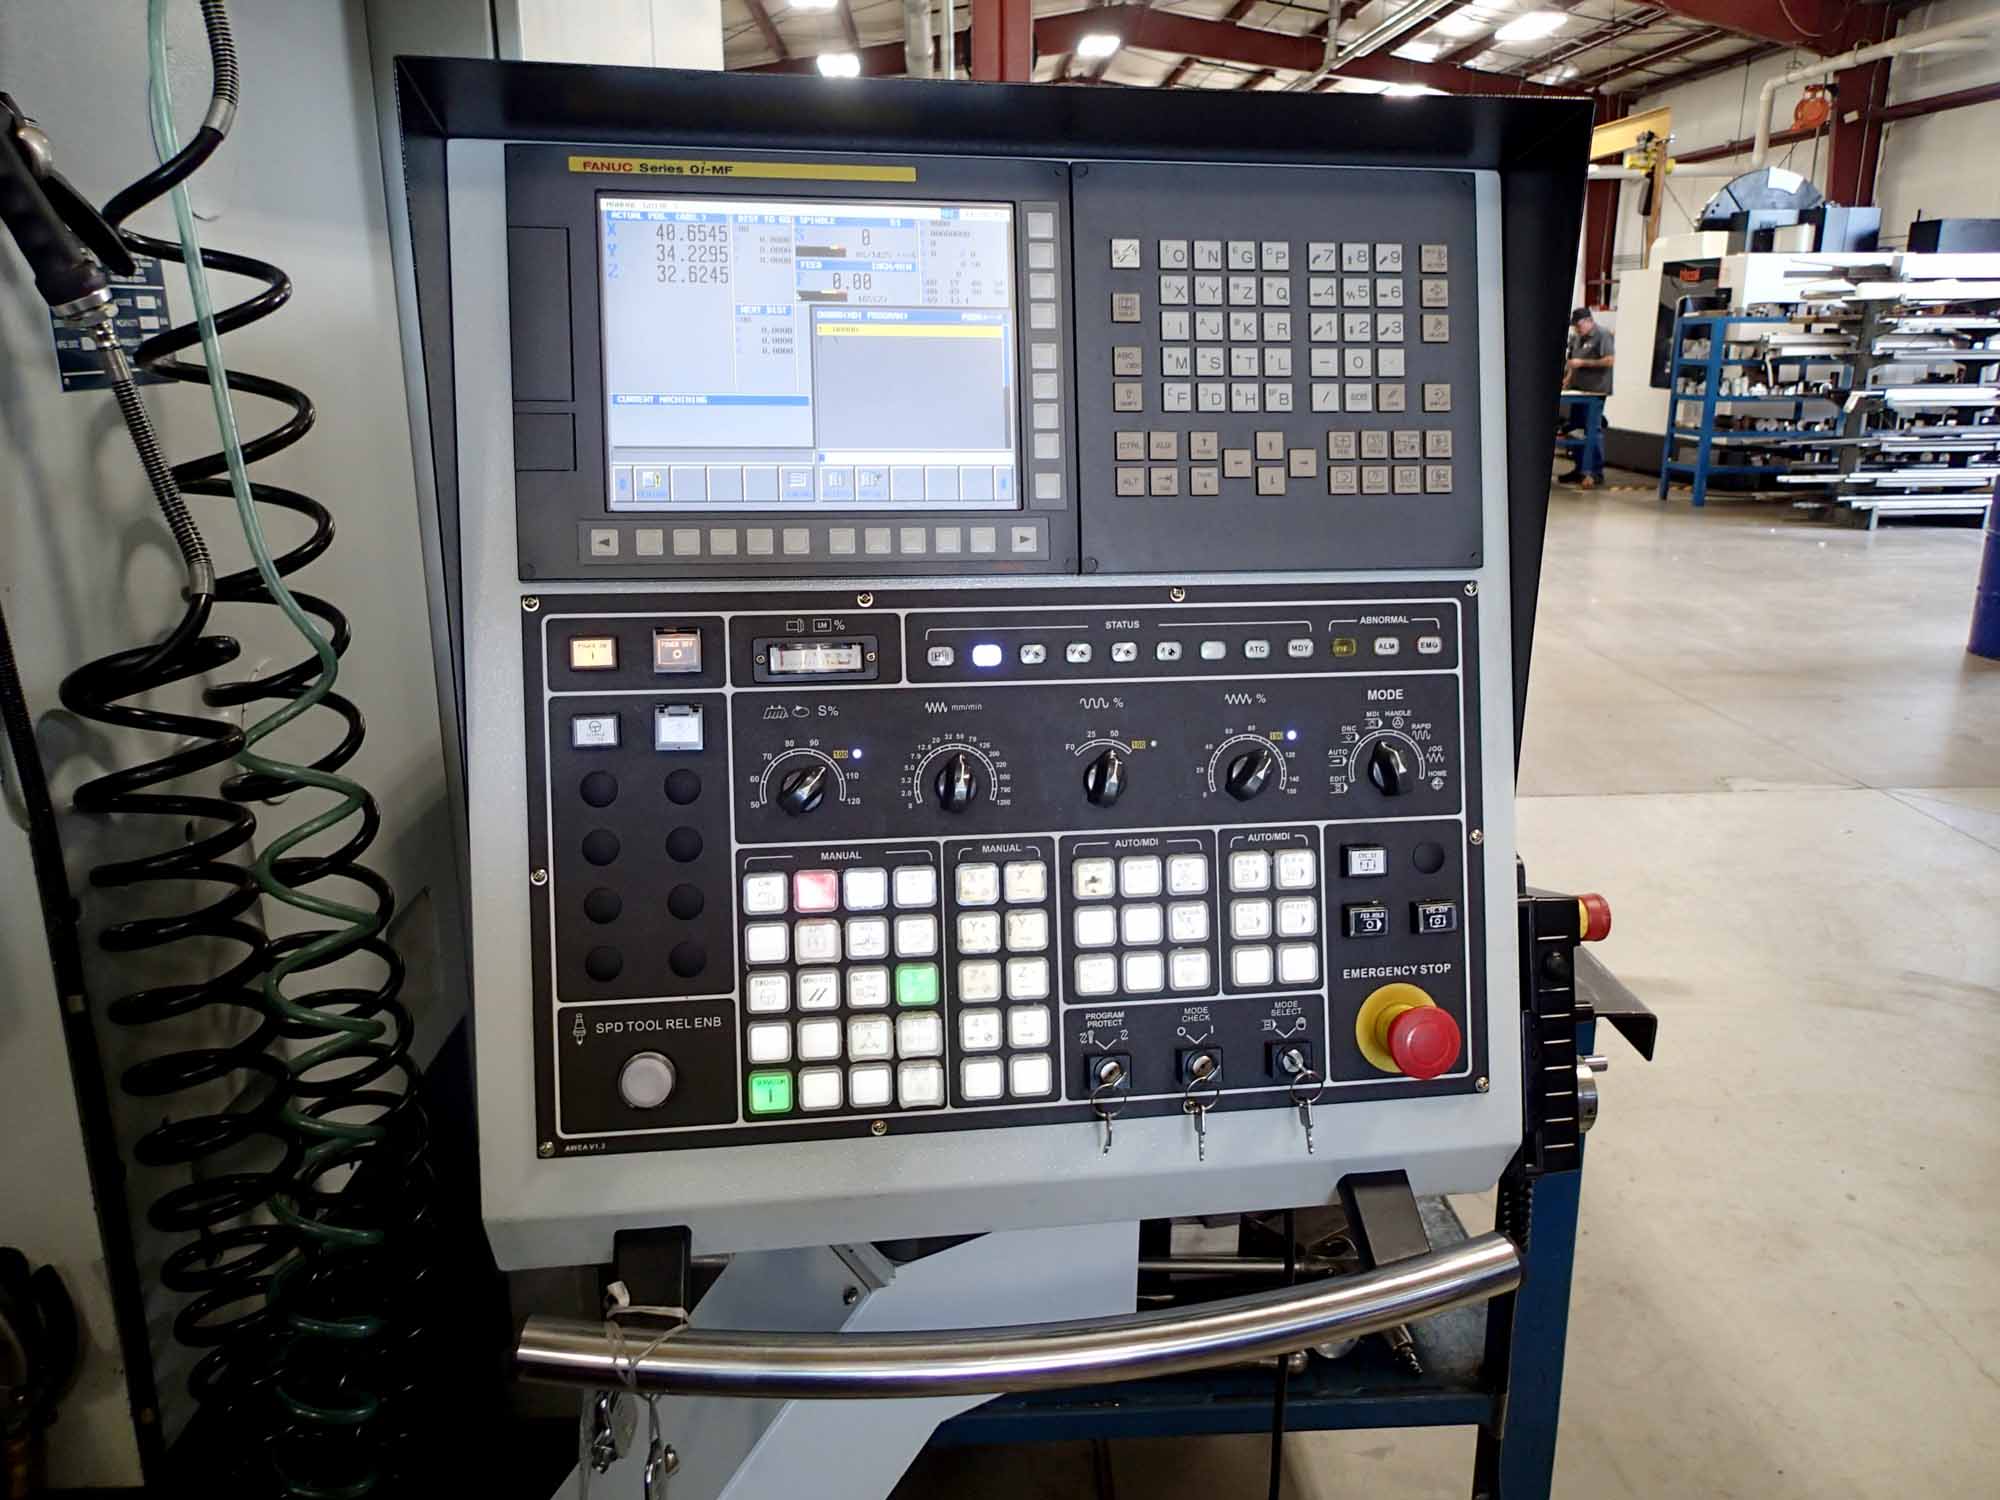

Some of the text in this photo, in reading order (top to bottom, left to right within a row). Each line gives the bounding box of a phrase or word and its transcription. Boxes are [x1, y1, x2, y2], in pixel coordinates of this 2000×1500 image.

[583, 161, 633, 172] FANUC
[639, 163, 684, 174] Series
[656, 223, 729, 242] 40.6545
[657, 244, 729, 263] 34.2295
[1207, 250, 1219, 263] N
[1241, 250, 1253, 264] G
[1275, 250, 1286, 264] P
[1323, 249, 1333, 262] 7
[1356, 250, 1368, 264] 8
[1390, 250, 1401, 264] 9
[657, 265, 729, 284] 32.6245
[833, 272, 872, 290] 0.00
[1175, 286, 1185, 299] X
[1208, 287, 1219, 299] Y
[1243, 287, 1253, 300] Z
[1276, 287, 1288, 301] Q
[1323, 285, 1334, 297] 4
[1358, 285, 1368, 299] 5
[1391, 286, 1401, 299] 6
[1209, 322, 1220, 335] J
[1243, 322, 1253, 335] K
[1277, 322, 1288, 335] R
[1326, 321, 1333, 334] 1
[1359, 320, 1369, 334] 2
[1391, 320, 1401, 334] 3
[1176, 356, 1187, 369] M
[1209, 356, 1221, 370] S
[1244, 356, 1256, 369] T
[1278, 357, 1289, 370] L
[1177, 392, 1187, 405] F
[1211, 392, 1222, 406] D
[1245, 391, 1256, 406] H
[1279, 393, 1289, 405] B
[834, 619, 846, 631] %
[1105, 620, 1140, 630] STATUS
[1359, 615, 1409, 625] ABNORMAL
[1378, 643, 1395, 651] ALM
[1421, 641, 1438, 649] EMG
[1367, 689, 1404, 700] MODE
[951, 703, 983, 712] mm/min
[1114, 838, 1159, 848] AUTO/MDI
[1247, 832, 1291, 842] AUTO/MDI
[982, 843, 1022, 853] MANUAL
[820, 852, 862, 861] MANUAL
[1343, 963, 1452, 979] EMERGENCY STOP
[1184, 1007, 1209, 1016] MODE
[1274, 1001, 1299, 1009] MODE
[1085, 1012, 1125, 1020] PROGRAM
[1182, 1014, 1211, 1023] CHECK
[1271, 1008, 1302, 1017] SELECT
[596, 1016, 722, 1034] SPD TOOL REL ENB
[1087, 1019, 1123, 1028] PROTECT
